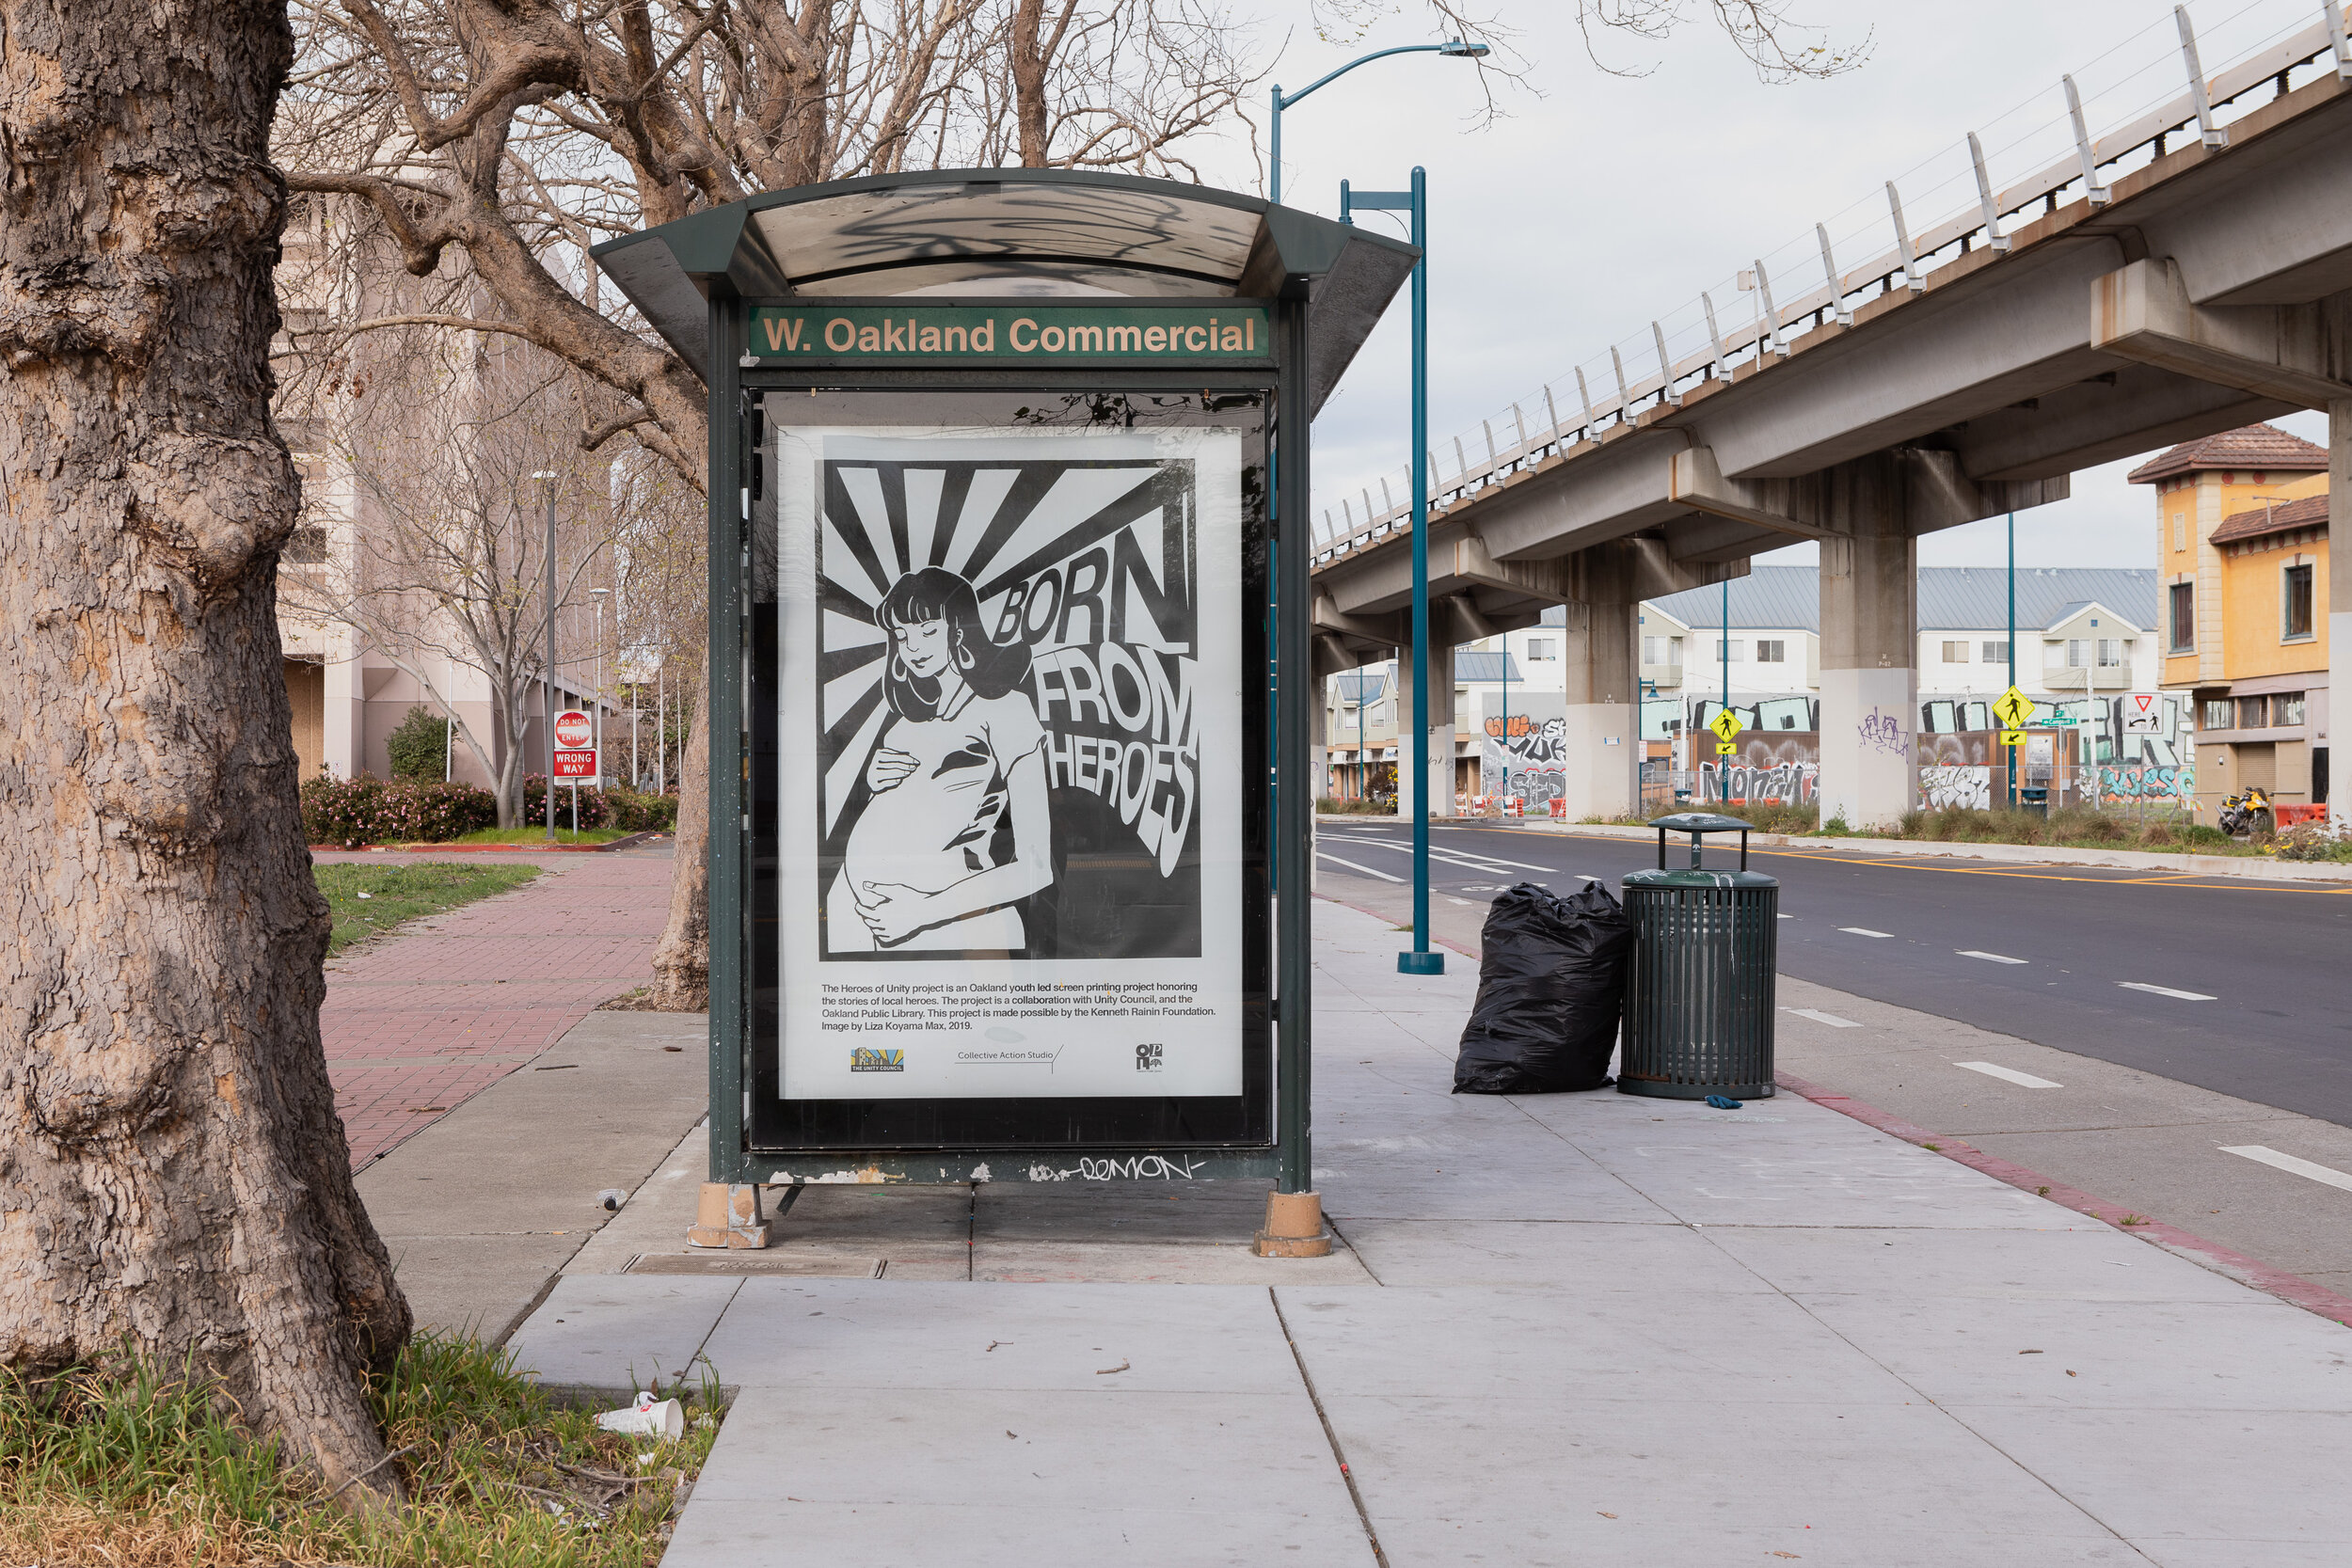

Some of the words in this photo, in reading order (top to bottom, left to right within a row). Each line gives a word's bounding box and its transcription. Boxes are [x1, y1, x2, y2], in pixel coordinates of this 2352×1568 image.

[763, 318, 811, 352] W.
[823, 318, 995, 352] Oakland
[1009, 318, 1254, 352] Commercial
[993, 504, 1188, 645] BORN
[1032, 641, 1200, 760] FROM
[556, 753, 592, 763] WRONG
[563, 764, 584, 774] WAY
[1045, 729, 1195, 879] HEROES
[821, 984, 839, 992] The
[840, 984, 873, 992] Heroes
[875, 984, 885, 992] of
[886, 984, 911, 994] Unity
[913, 984, 944, 994] project
[946, 983, 954, 992] is
[969, 983, 1008, 992] Oakland
[1009, 983, 1035, 993] youth
[1037, 983, 1051, 991] led
[1086, 983, 1121, 993] printing
[1123, 983, 1154, 993] project
[1156, 982, 1198, 993] honoring
[821, 996, 836, 1006] the
[838, 996, 868, 1006] stories
[870, 996, 881, 1005] of
[882, 996, 903, 1005] local
[905, 996, 939, 1005] heroes.
[941, 996, 959, 1005] The
[961, 996, 993, 1006] project
[994, 995, 1002, 1005] is
[1012, 995, 1071, 1005] collaboration
[1073, 995, 1092, 1004] with
[1094, 995, 1118, 1006] Unity
[1120, 995, 1157, 1006] Council,
[1158, 995, 1176, 1004] and
[1178, 994, 1193, 1004] the
[821, 1008, 859, 1018] Oakland
[861, 1008, 890, 1018] Public
[892, 1008, 926, 1019] Library.
[928, 1008, 946, 1017] This
[949, 1008, 981, 1019] project
[982, 1008, 991, 1017] is
[993, 1008, 1019, 1017] made
[1020, 1008, 1059, 1019] possible
[1060, 1007, 1073, 1019] by
[1074, 1007, 1089, 1017] the
[1090, 1007, 1129, 1017] Kenneth
[1131, 1007, 1160, 1016] Rainin
[1162, 1007, 1216, 1016] Foundation.
[821, 1022, 850, 1032] Image
[850, 1022, 863, 1032] by
[865, 1021, 883, 1030] Liza
[885, 1021, 923, 1032] Koyama
[925, 1021, 946, 1031] Max,
[948, 1021, 973, 1030] 2019.
[958, 1051, 997, 1060] Collective
[999, 1051, 1026, 1060] Action
[1027, 1051, 1054, 1060] Studio
